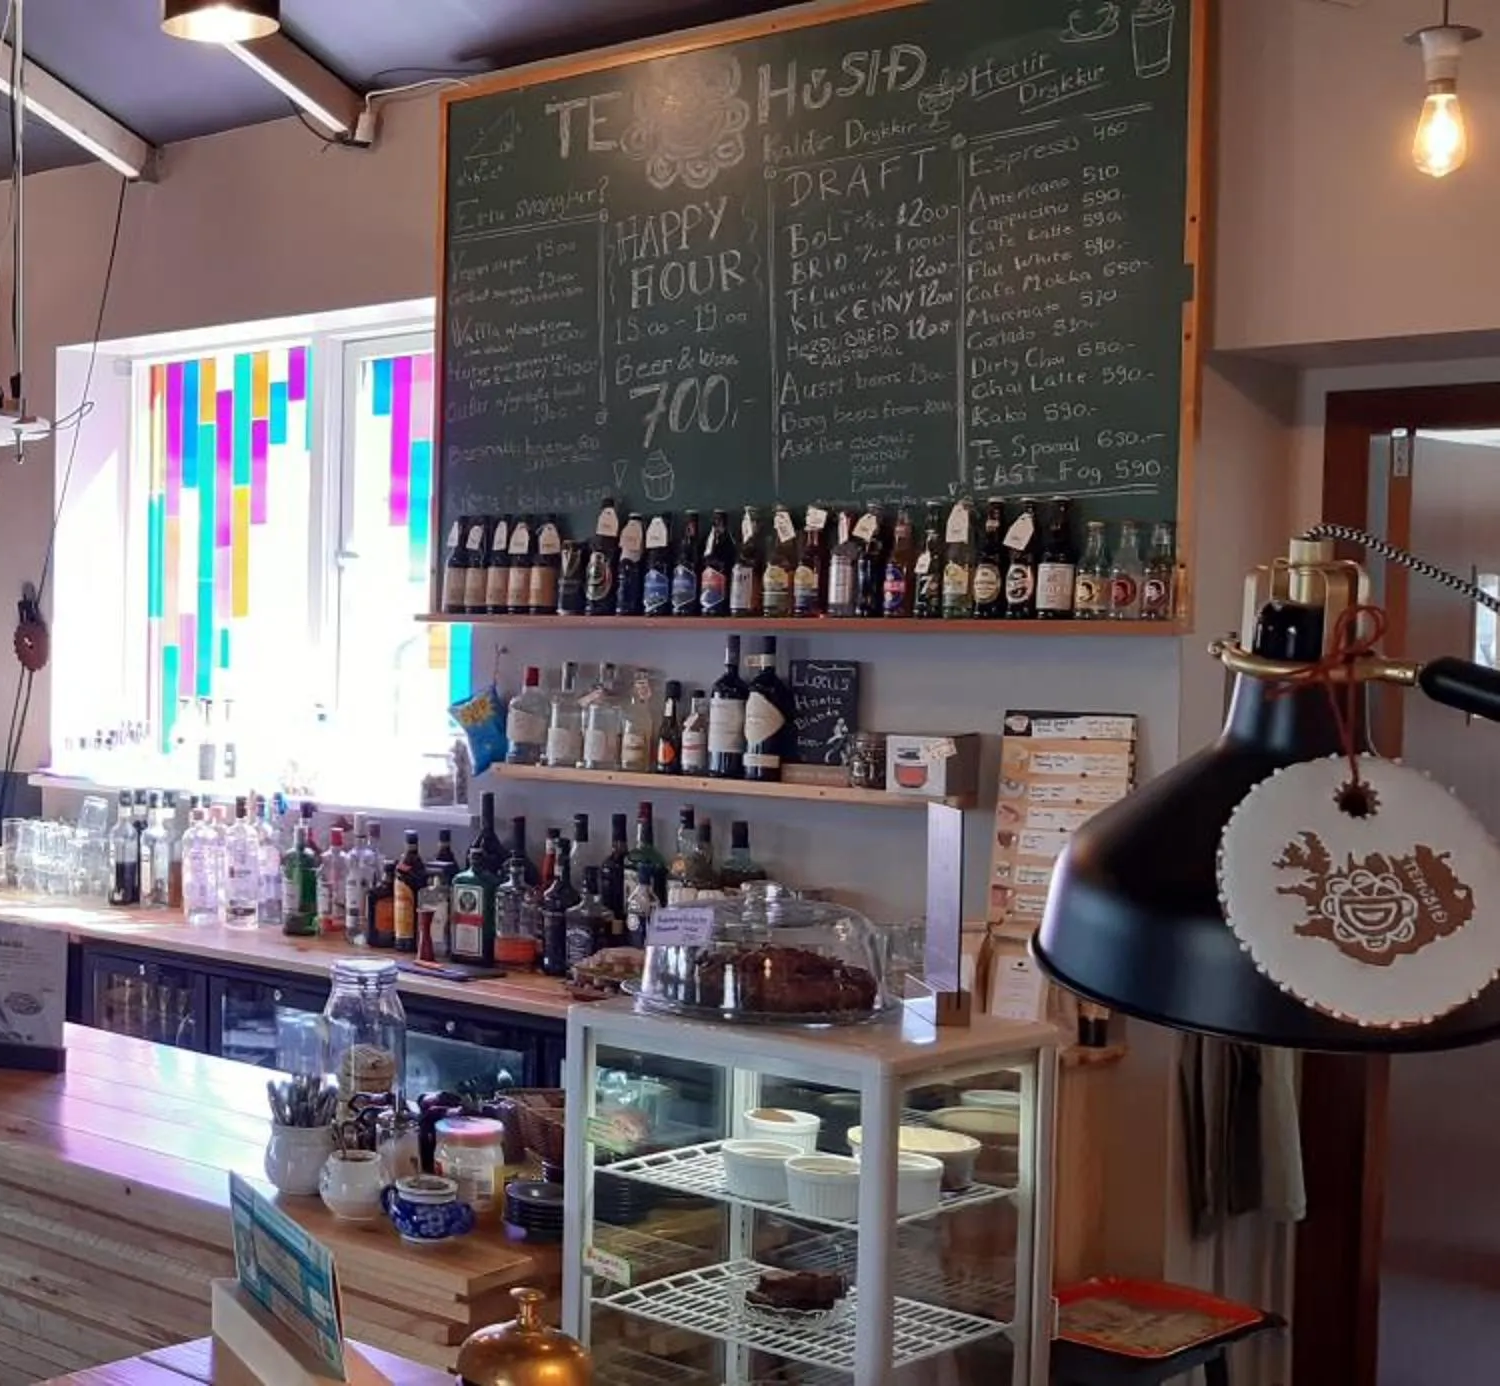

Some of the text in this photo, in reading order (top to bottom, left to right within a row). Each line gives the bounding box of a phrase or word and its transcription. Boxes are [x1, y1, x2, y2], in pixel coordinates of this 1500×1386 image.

[544, 90, 623, 158] TE
[784, 146, 937, 207] DRAFT
[969, 136, 1081, 178] Espresso
[969, 177, 1070, 213] Americano
[616, 195, 729, 267] HAPPY
[630, 248, 746, 310] HOUR
[1013, 252, 1074, 271] White
[790, 289, 915, 335] KILKENNY
[615, 353, 673, 386] Beer
[970, 355, 1020, 380] Dirty
[1025, 346, 1066, 369] Chai
[1030, 370, 1088, 392] Latte
[1059, 457, 1102, 486] Fog
